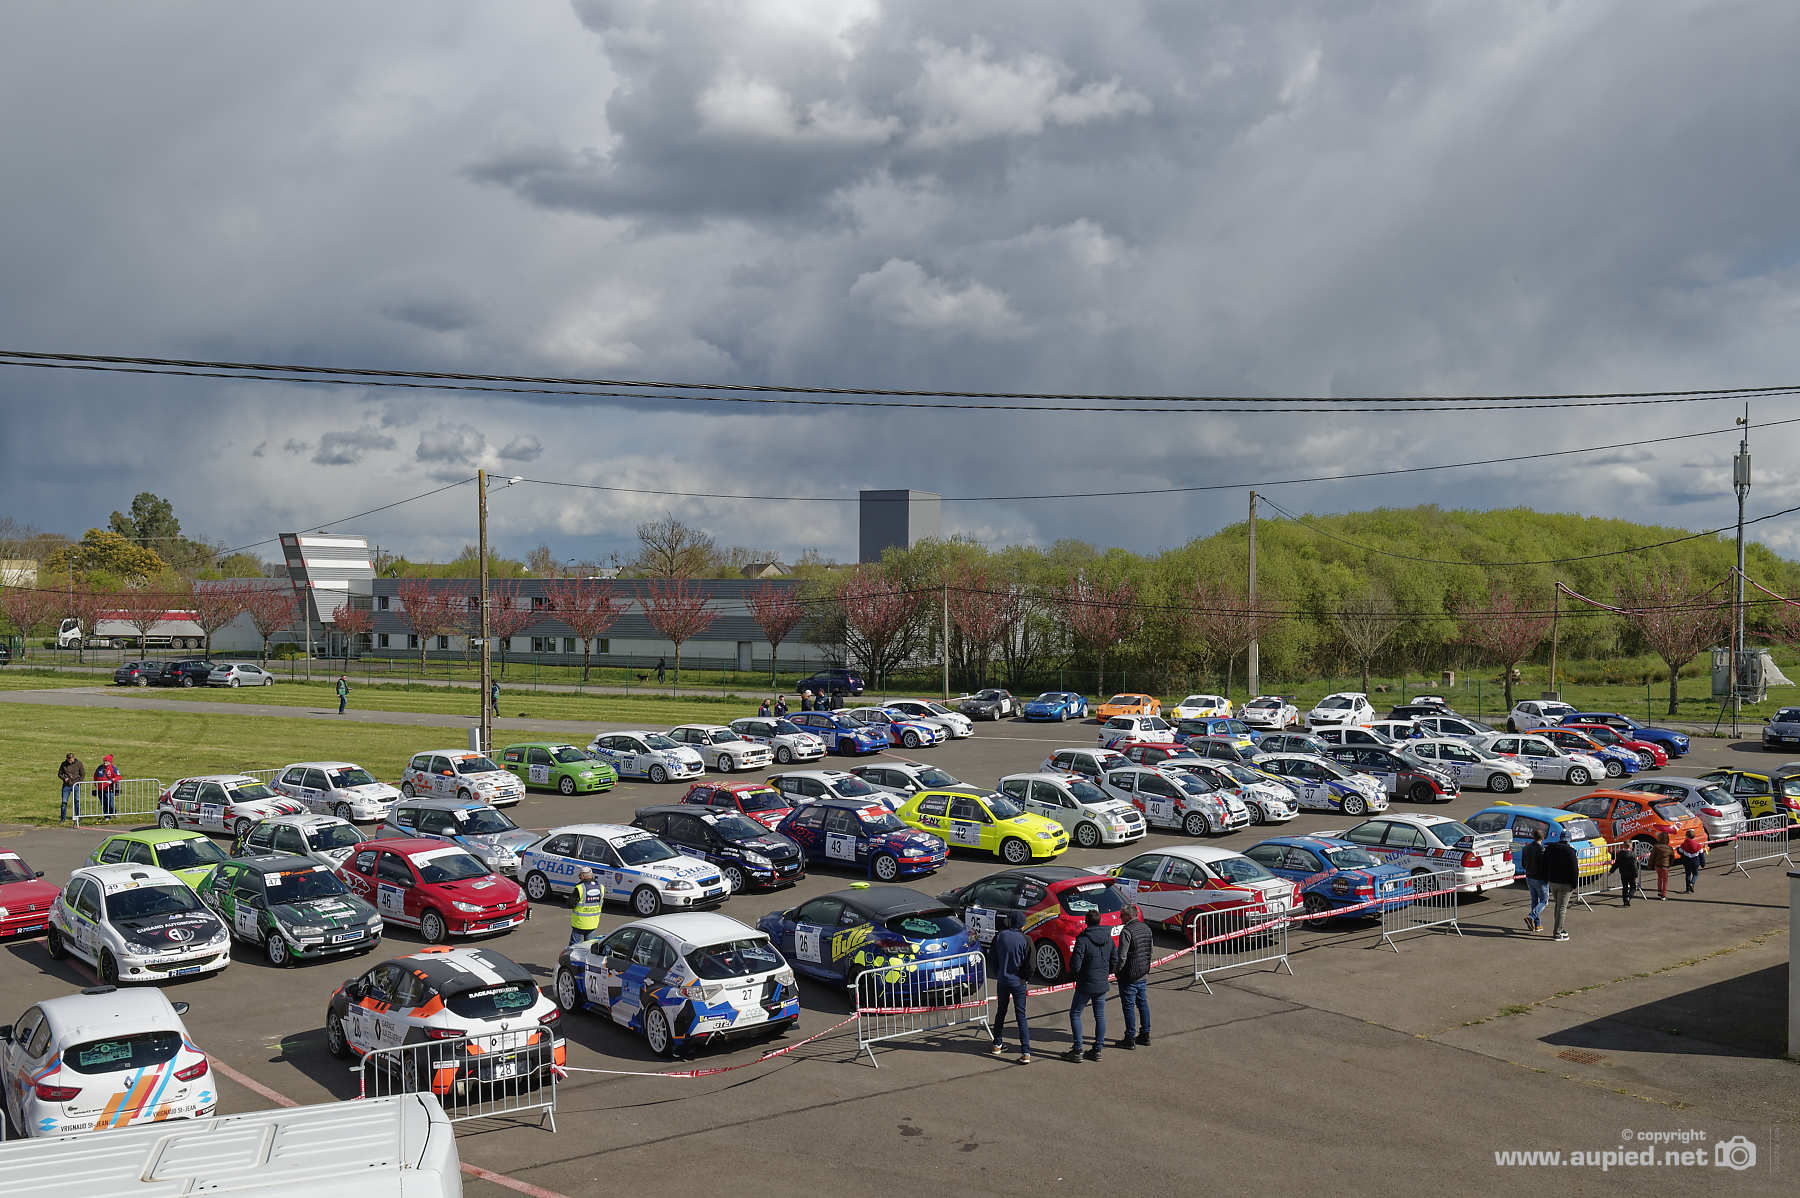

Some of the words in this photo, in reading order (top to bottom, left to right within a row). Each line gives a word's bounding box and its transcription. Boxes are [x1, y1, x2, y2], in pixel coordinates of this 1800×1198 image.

[623, 760, 633, 770] 106
[1305, 788, 1315, 800] 37
[1151, 803, 1160, 815] 40
[955, 828, 966, 840] 42
[831, 840, 841, 854] 43
[536, 860, 575, 876] CHAB
[382, 893, 391, 909] 46
[136, 924, 164, 935] CUGAND
[799, 934, 809, 953] 26
[588, 974, 598, 991] 27
[742, 989, 753, 1001] 27
[500, 1064, 512, 1076] 28
[152, 1108, 176, 1118] VRIGNAUD
[60, 1122, 87, 1133] VRIGNAUD
